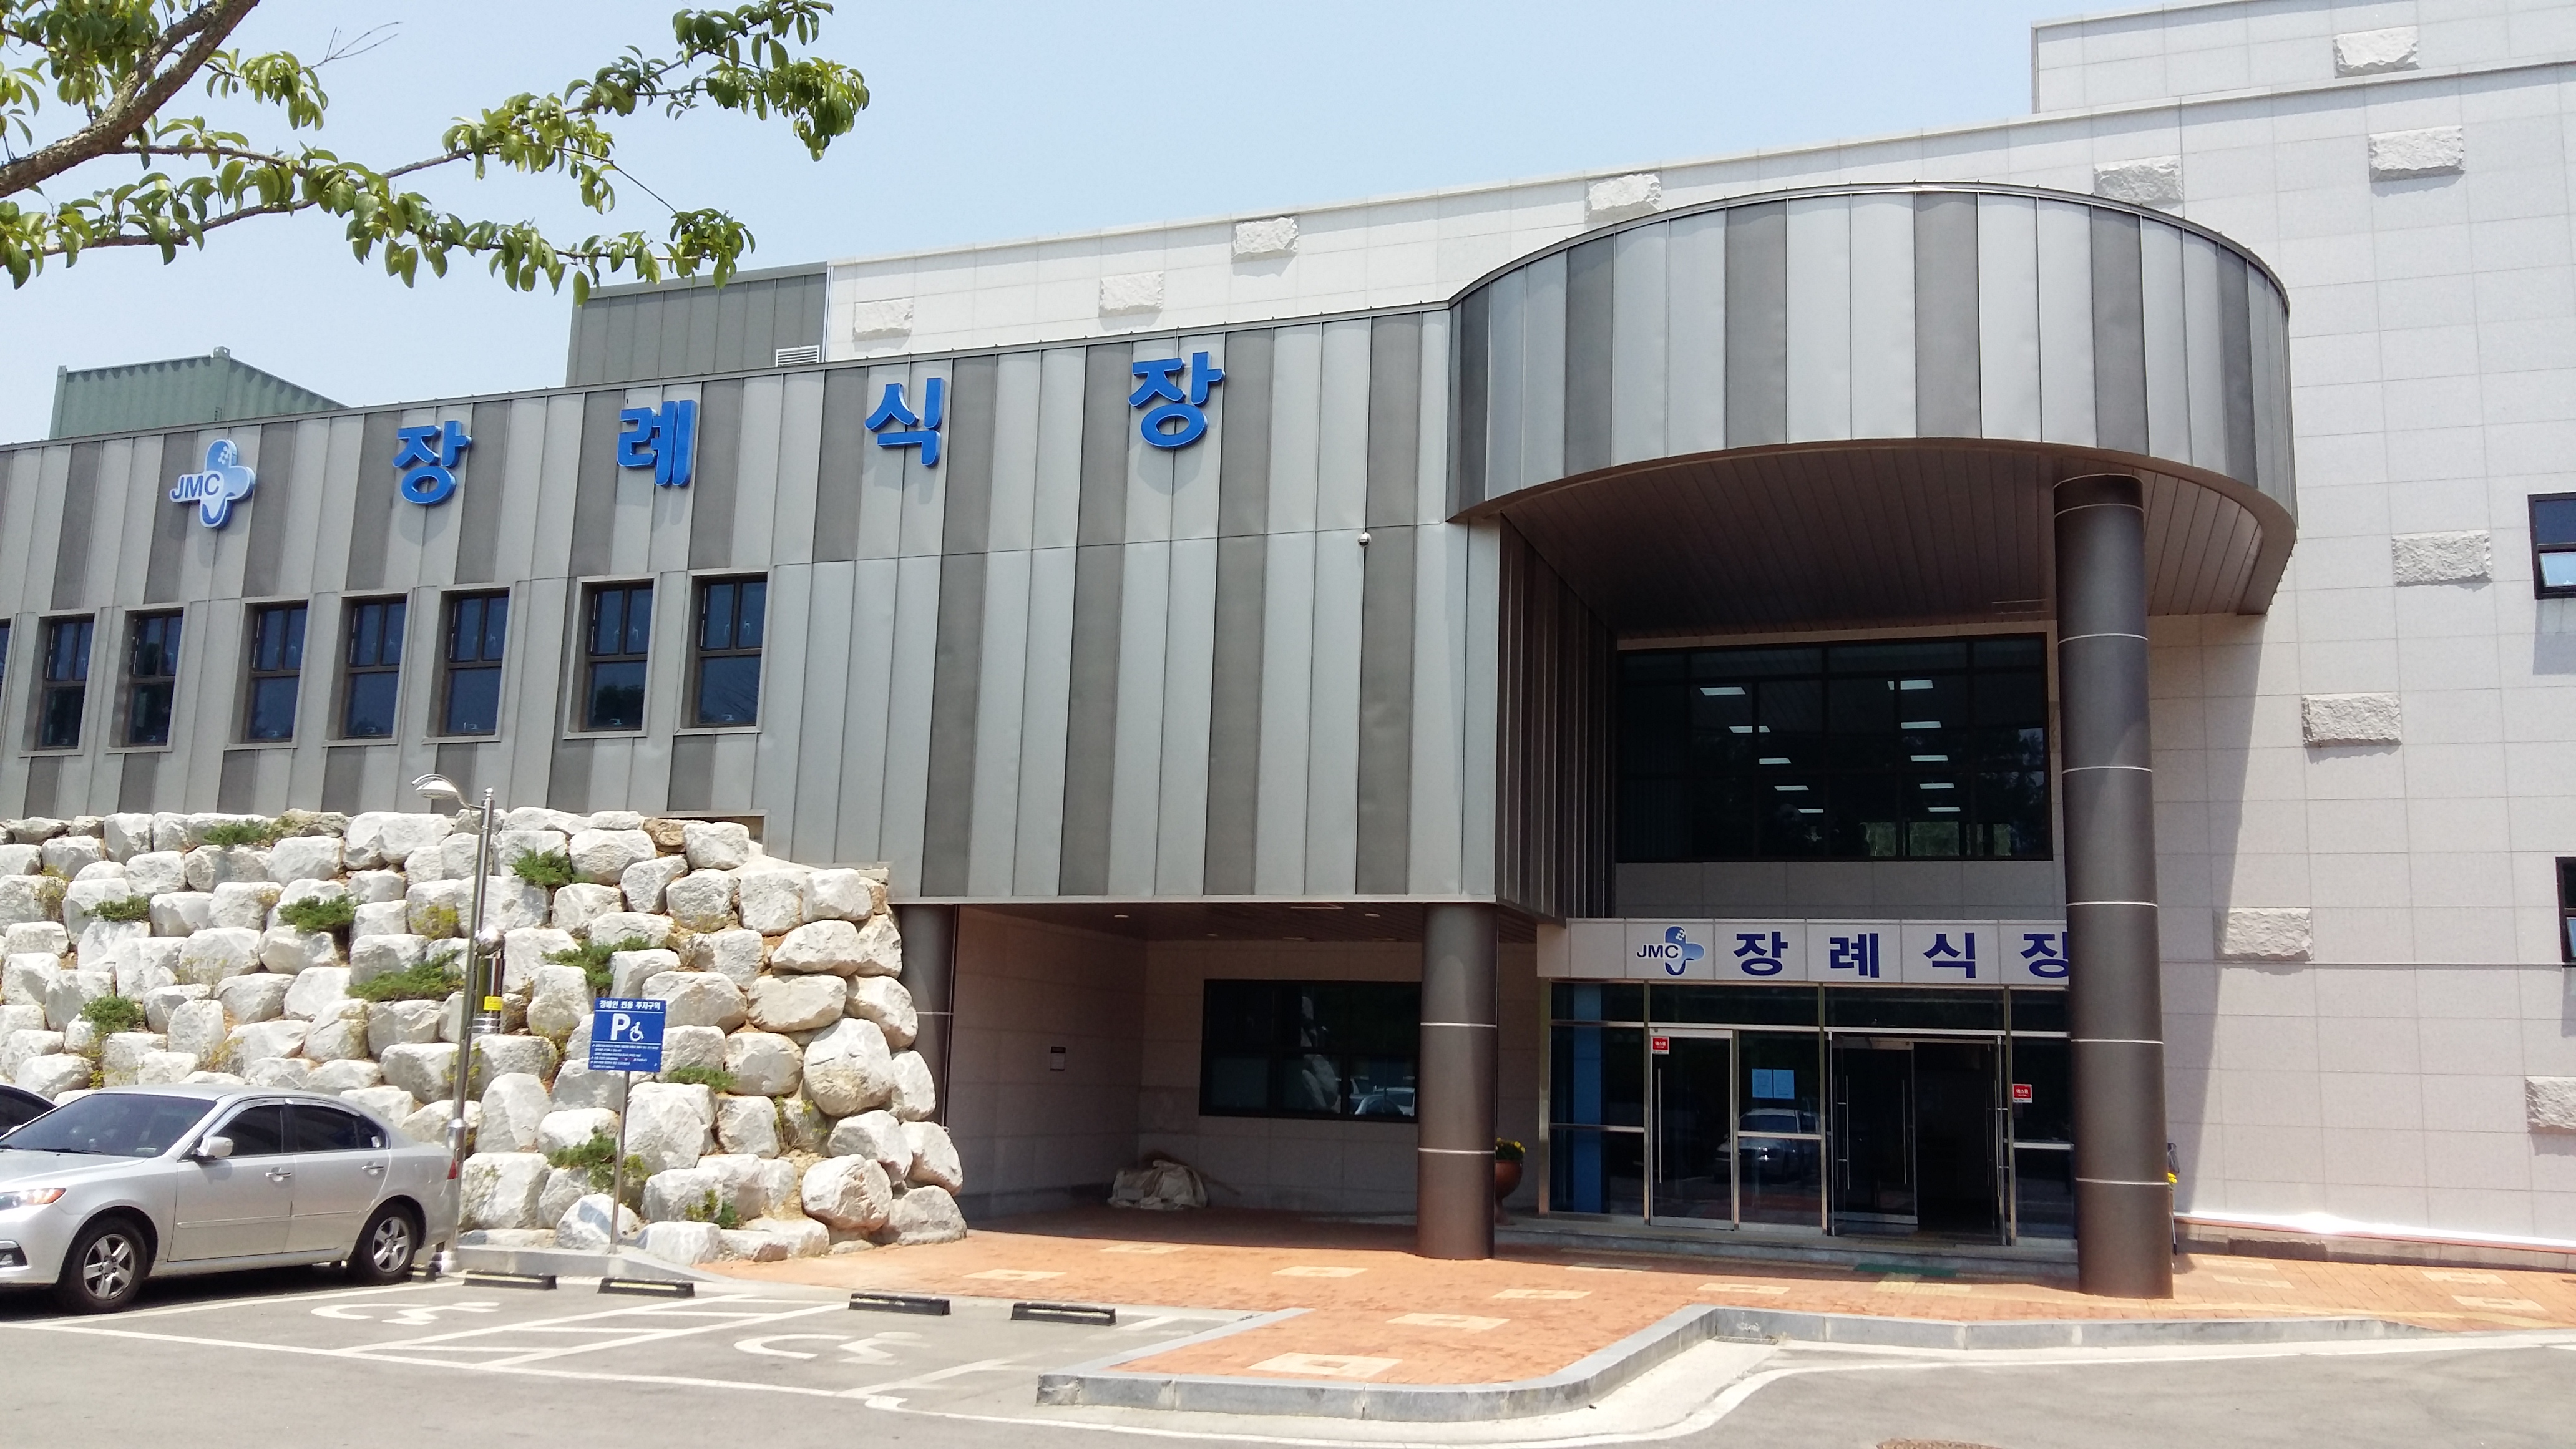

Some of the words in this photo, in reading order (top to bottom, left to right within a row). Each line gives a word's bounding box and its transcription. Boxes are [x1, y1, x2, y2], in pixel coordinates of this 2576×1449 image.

[172, 473, 220, 499] JMC
[1636, 944, 1679, 958] JMC
[600, 1000, 618, 1008] 장애인
[621, 1001, 633, 1009] 전용
[610, 1013, 630, 1040] P
